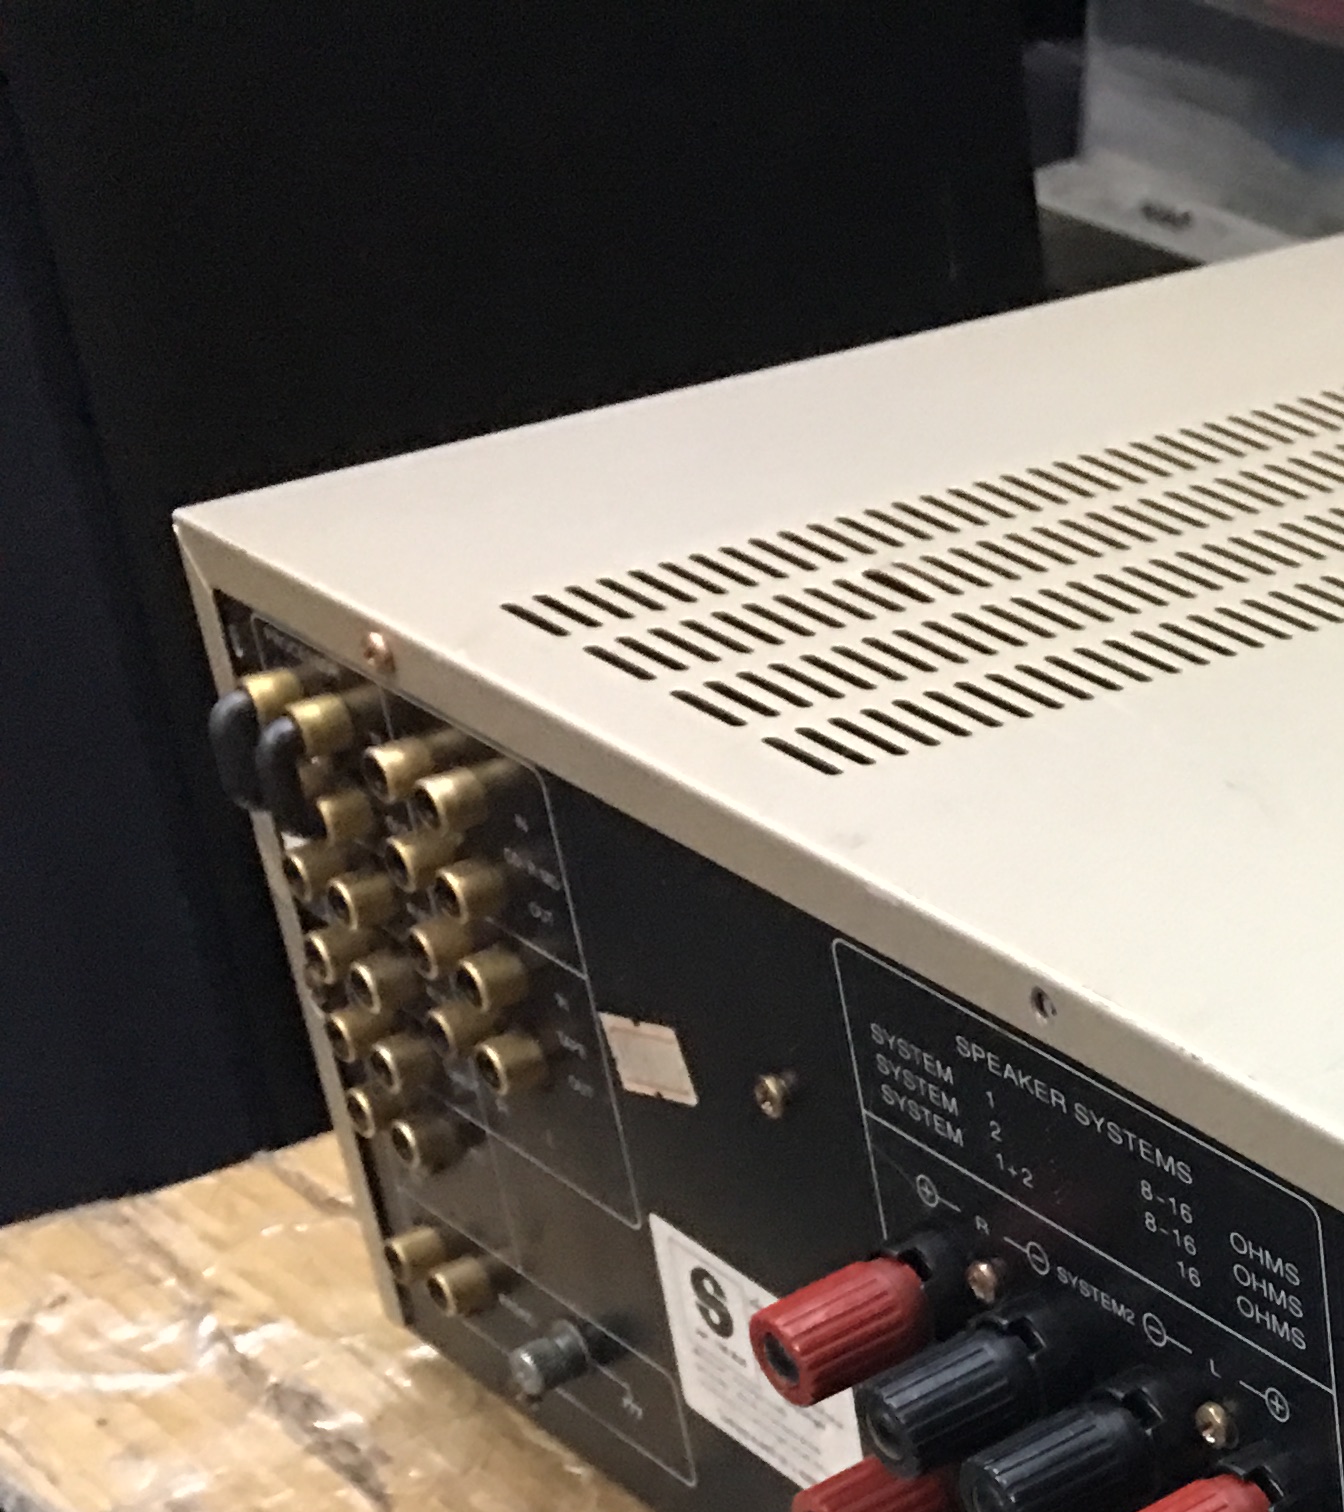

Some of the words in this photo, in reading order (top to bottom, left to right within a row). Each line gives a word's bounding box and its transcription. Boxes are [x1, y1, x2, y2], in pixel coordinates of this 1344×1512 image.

[870, 1022, 954, 1085] SYSTEM
[985, 1091, 994, 1109] 1
[1140, 1180, 1193, 1224] 8-16
[1230, 1232, 1300, 1286] OHMS
[875, 1053, 959, 1116] SYSTEM
[989, 1120, 1002, 1142] 2
[1145, 1212, 1197, 1256] 8-16
[1233, 1264, 1304, 1318] OHMS
[881, 1083, 964, 1147] SYSTEM
[995, 1153, 1034, 1188] 1+2
[1177, 1261, 1201, 1288] 16
[1236, 1296, 1306, 1350] OHMS
[955, 1035, 1067, 1114] SPEAKER
[1074, 1102, 1193, 1185] SYSTEMS
[1056, 1266, 1136, 1326] SYSTEM2
